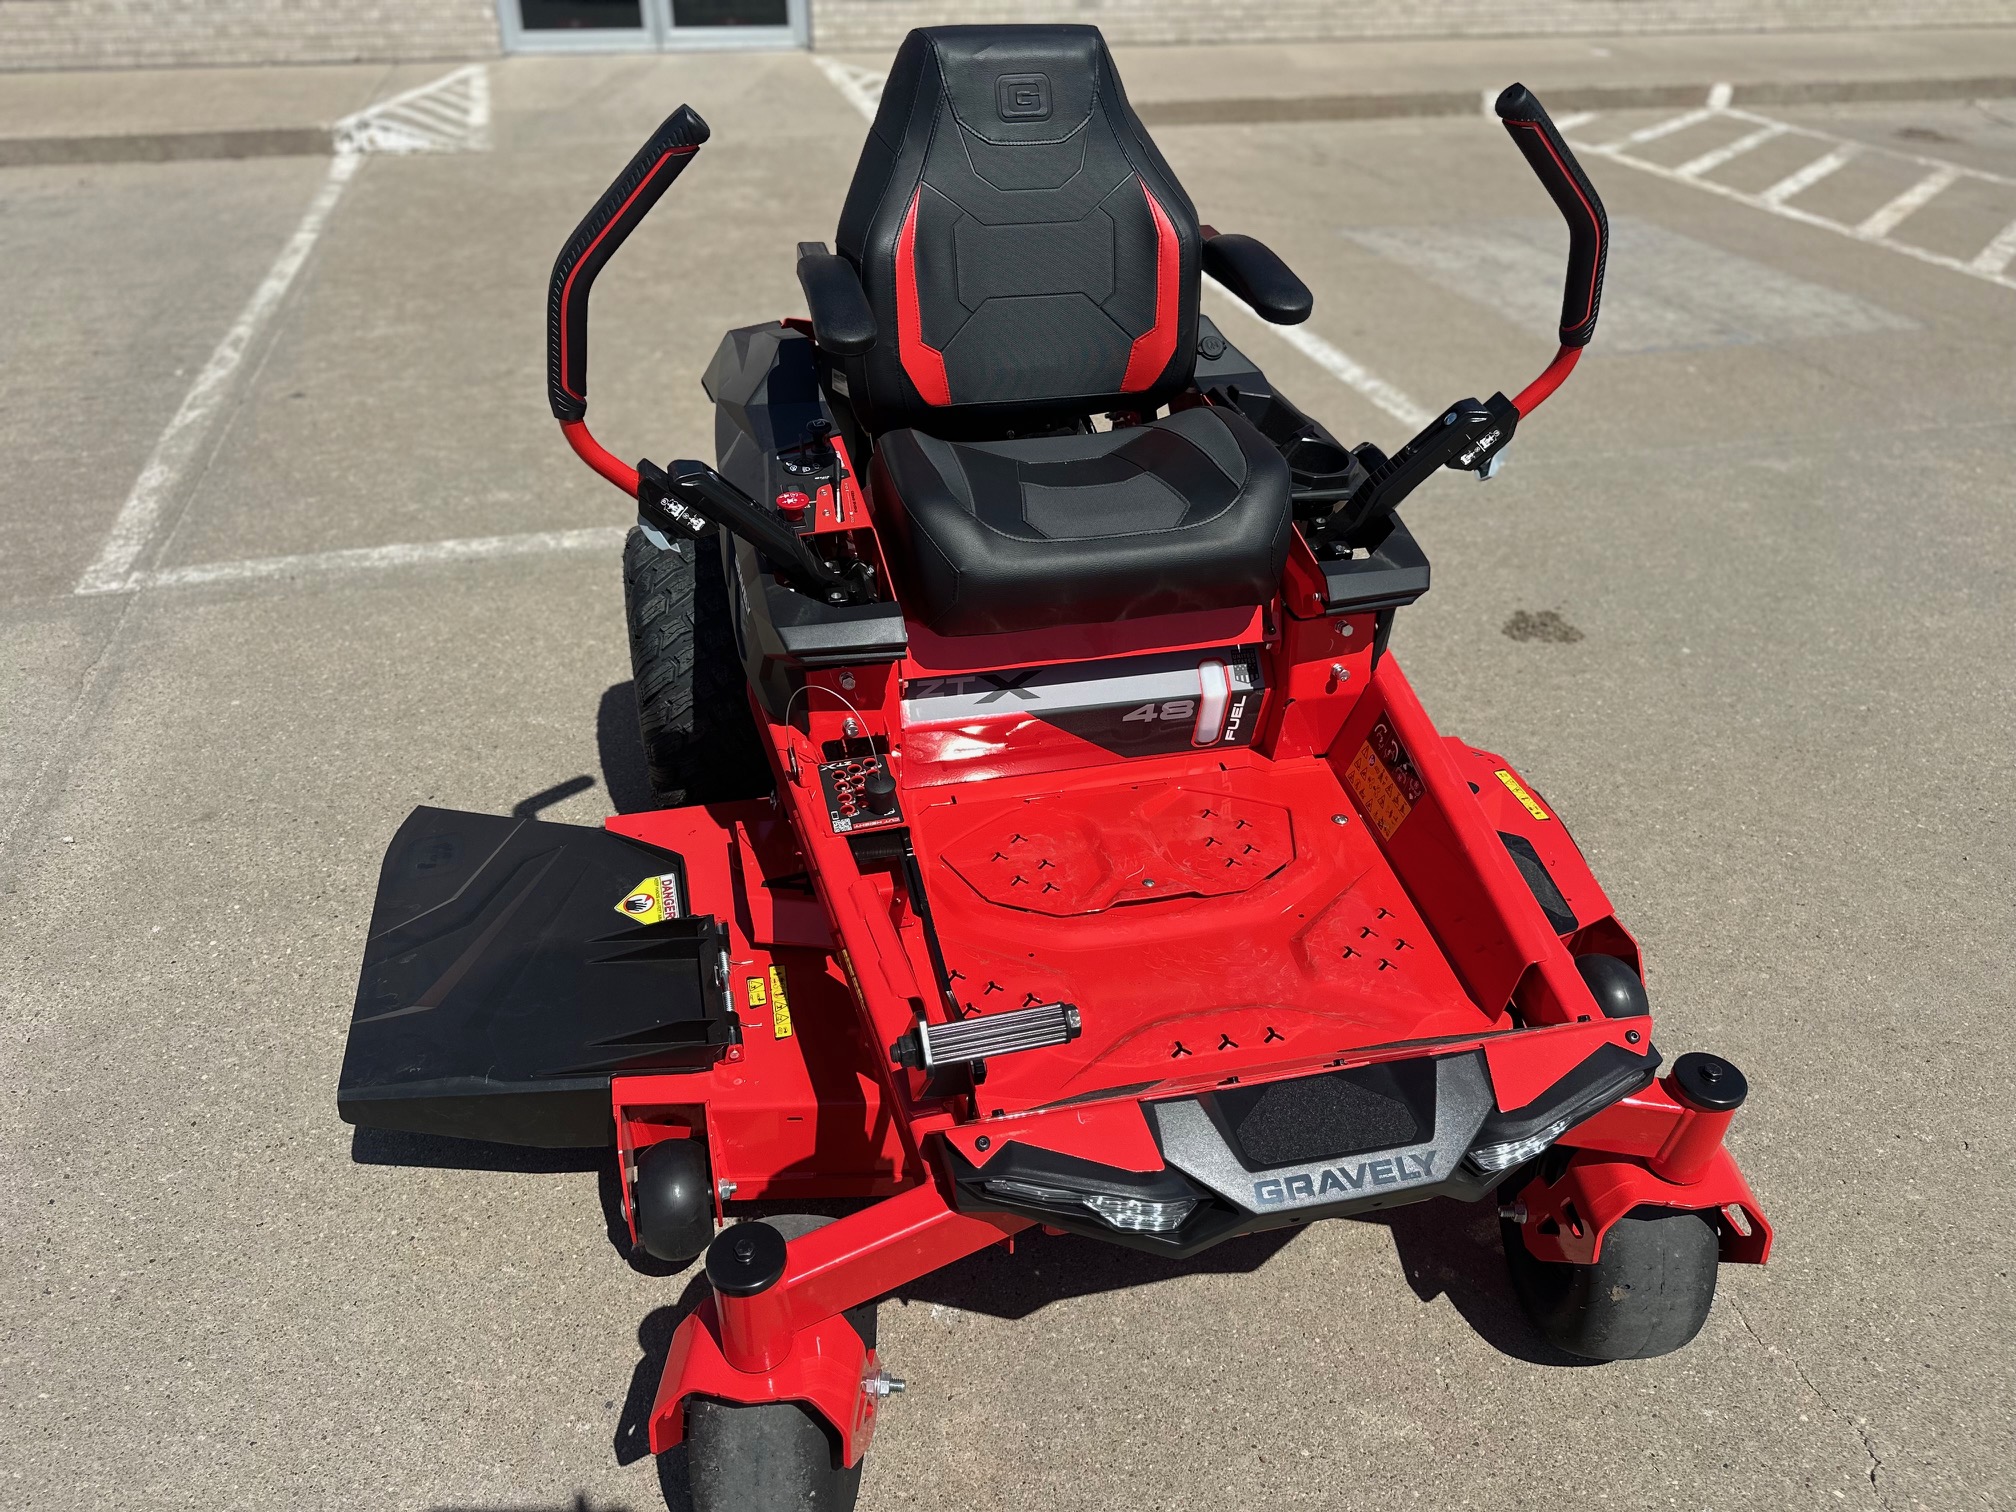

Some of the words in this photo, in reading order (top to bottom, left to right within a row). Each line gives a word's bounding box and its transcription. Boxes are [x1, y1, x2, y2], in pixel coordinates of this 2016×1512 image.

[1232, 652, 1255, 660] UNITED
[916, 669, 1043, 705] ZTX
[1122, 699, 1195, 723] 48
[1225, 695, 1247, 741] FUEL
[661, 879, 676, 920] DANGER
[1253, 1150, 1437, 1205] GRAVELY
